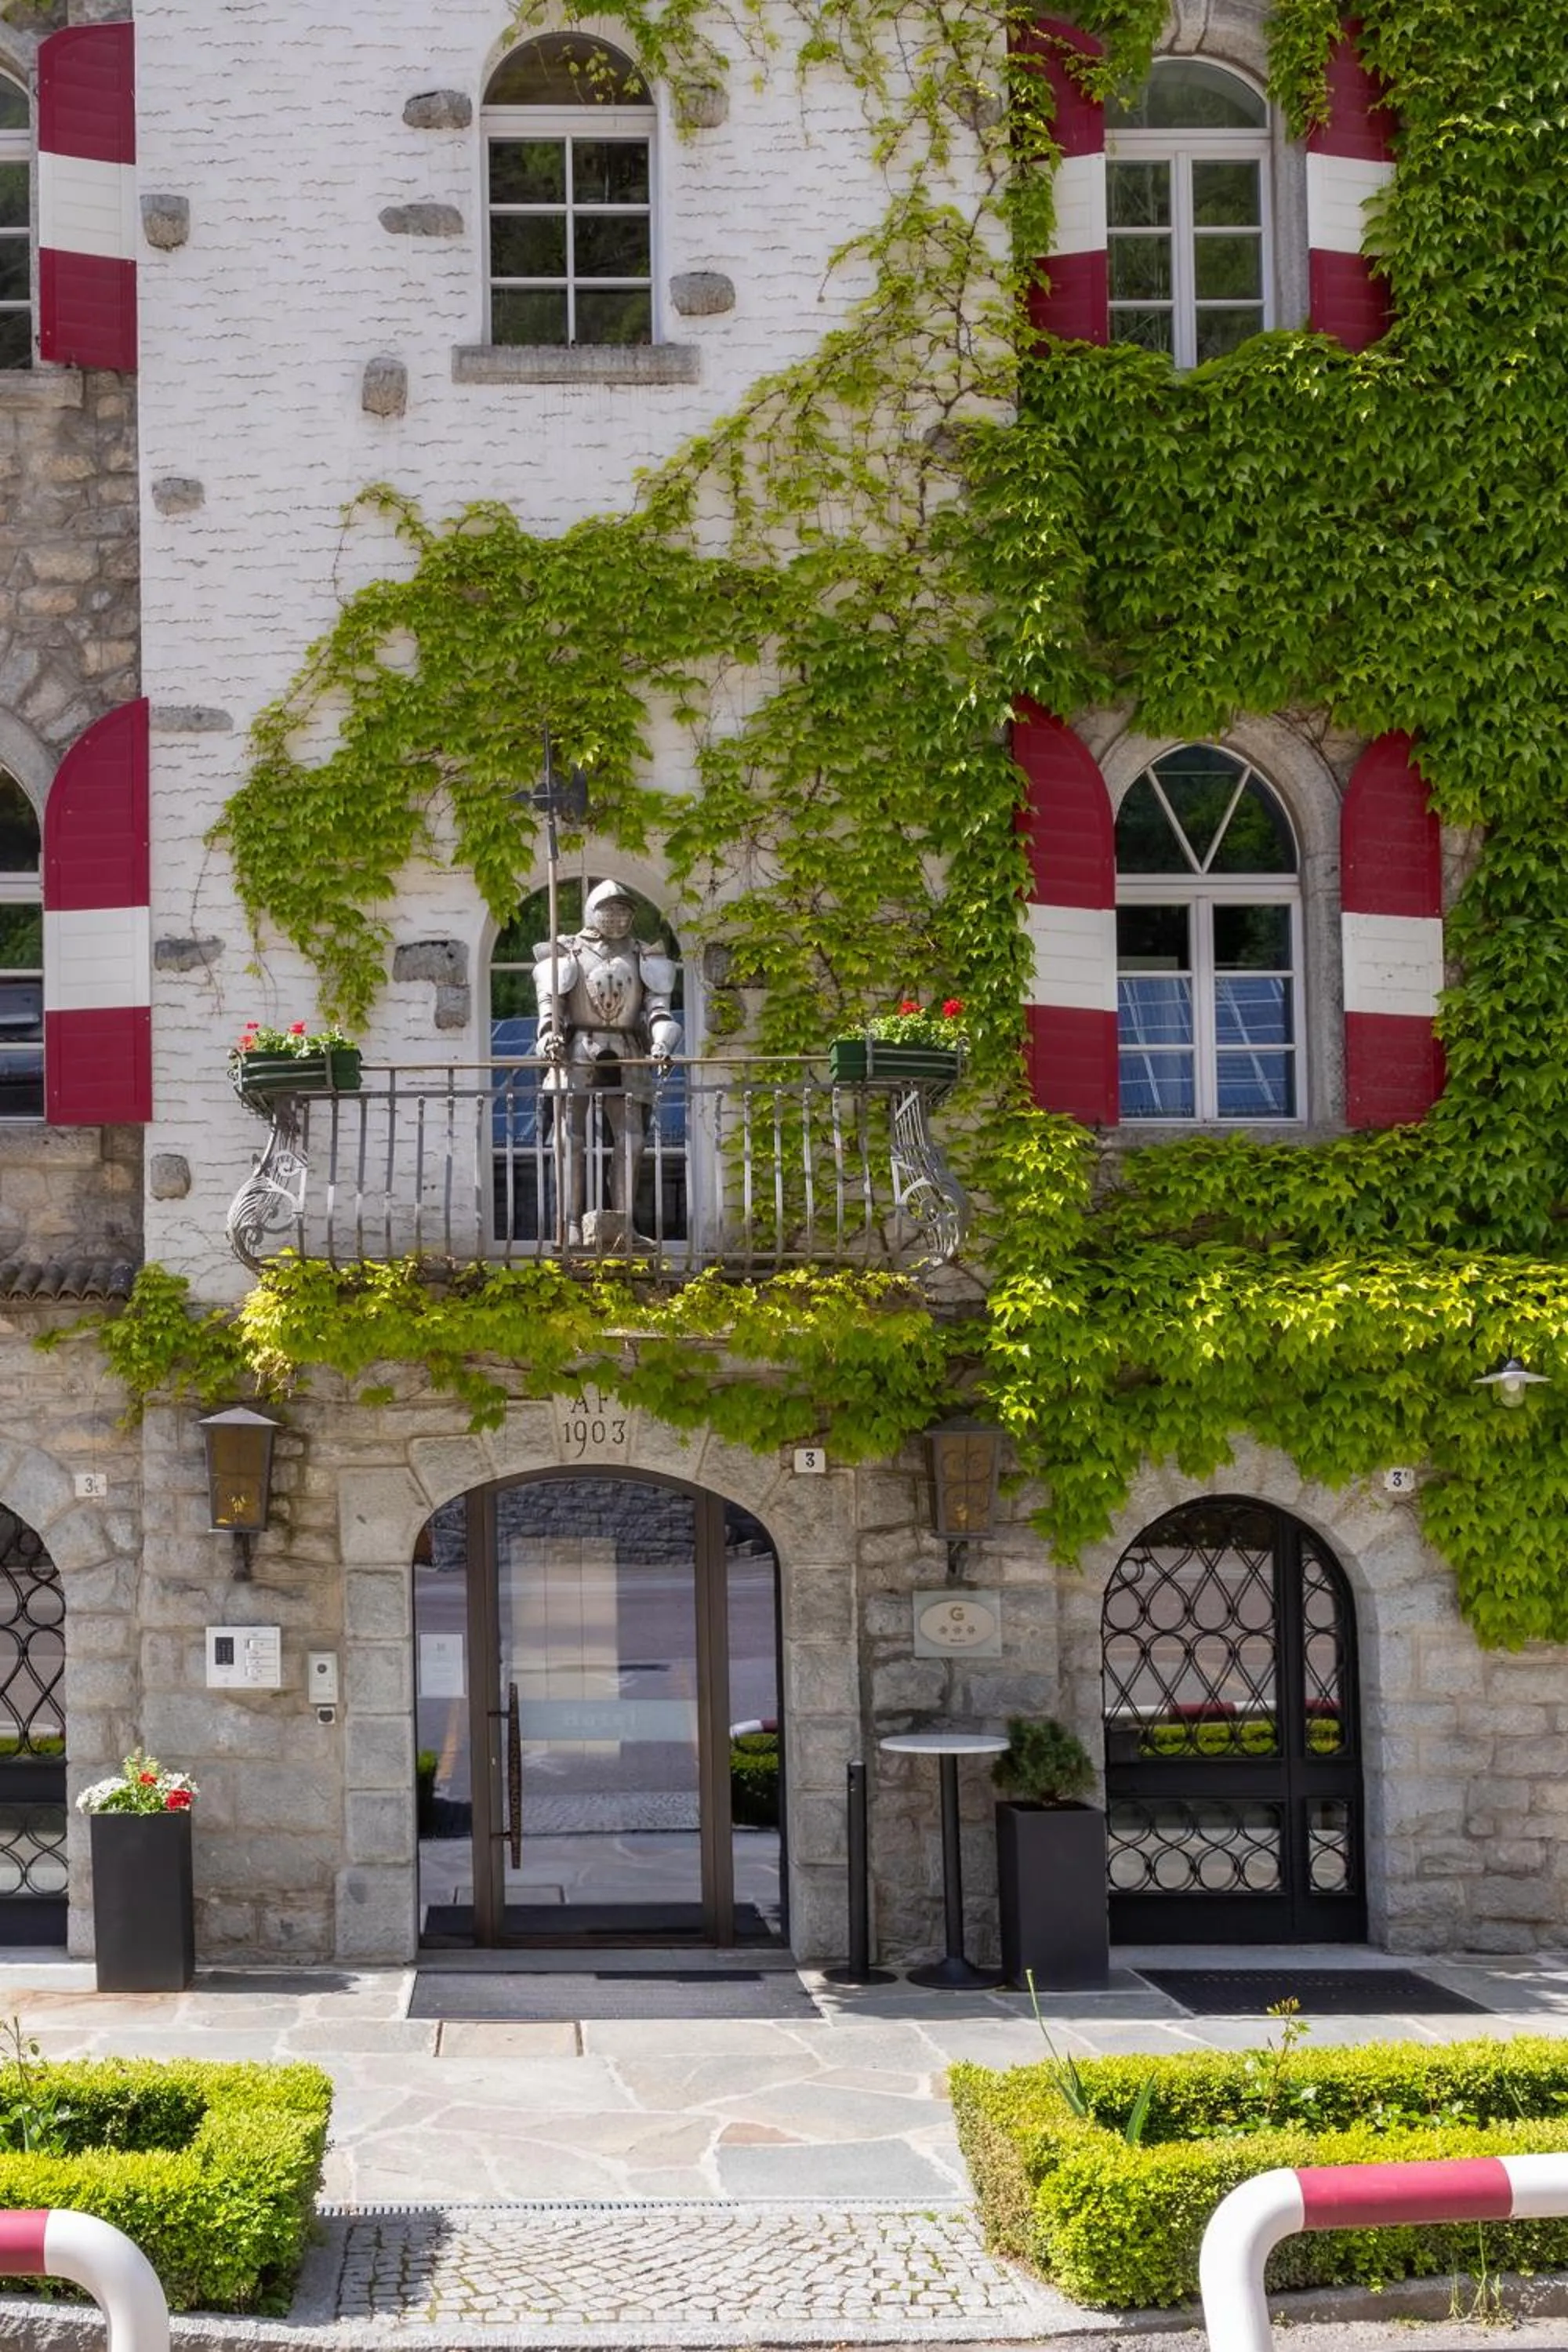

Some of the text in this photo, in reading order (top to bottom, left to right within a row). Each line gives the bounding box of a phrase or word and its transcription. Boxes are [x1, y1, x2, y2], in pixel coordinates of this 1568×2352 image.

[562, 1419, 626, 1458] 1903
[805, 1452, 815, 1468] 3
[949, 1606, 965, 1622] G
